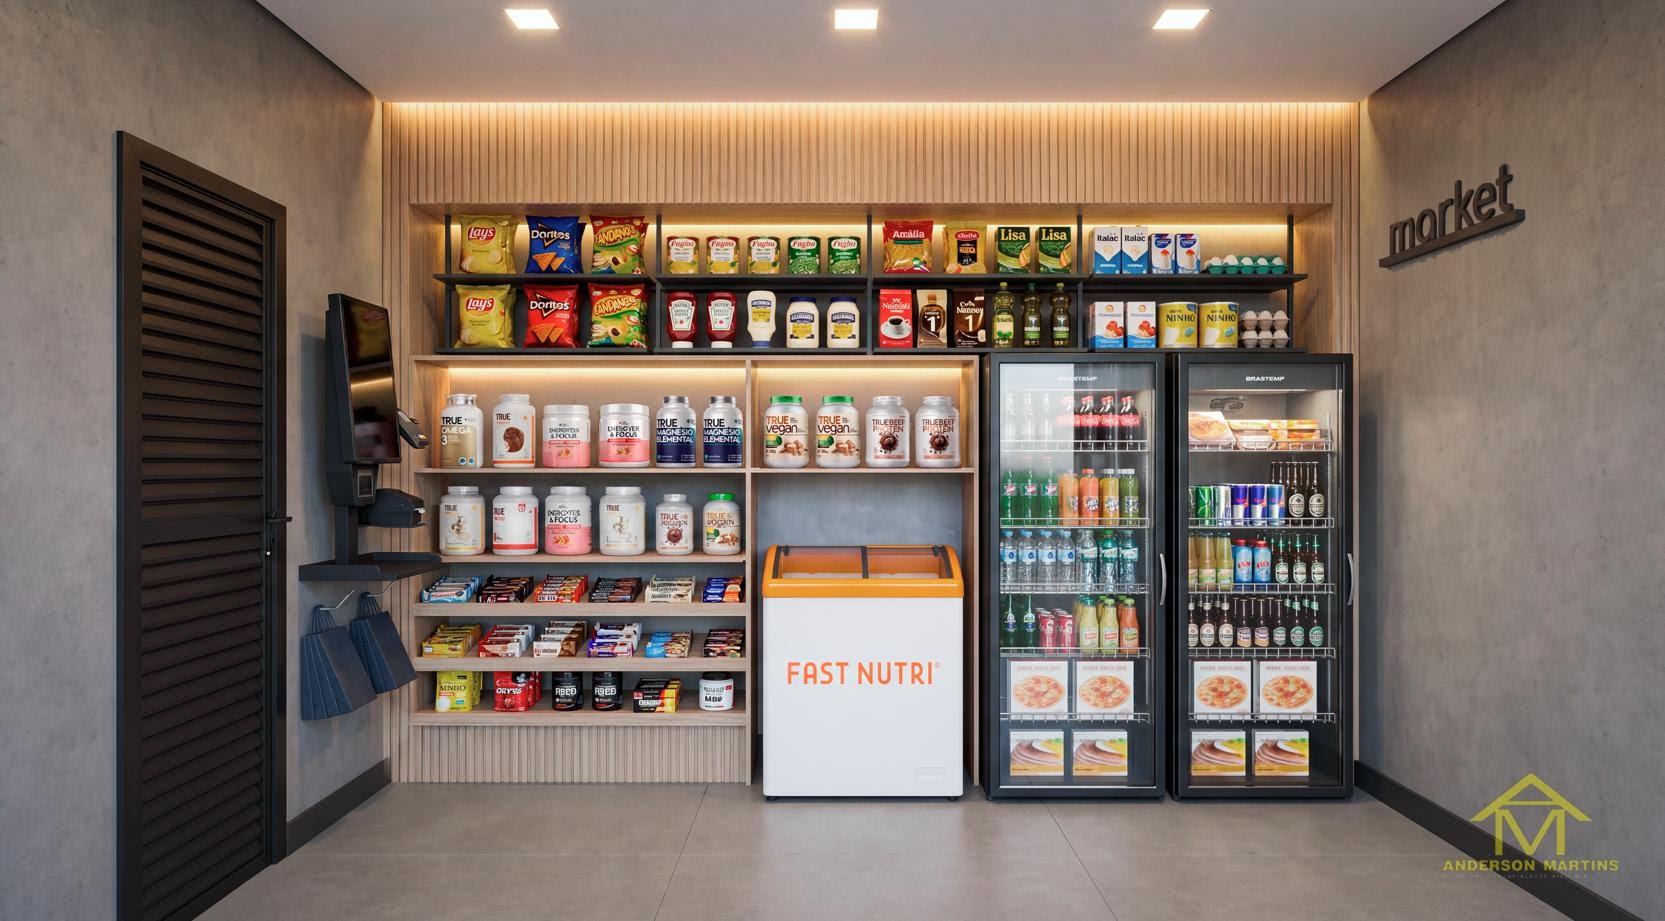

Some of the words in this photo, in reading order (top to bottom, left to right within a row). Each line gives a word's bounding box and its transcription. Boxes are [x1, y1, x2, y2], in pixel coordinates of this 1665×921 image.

[1389, 163, 1513, 256] market
[531, 230, 570, 240] Doritos
[1000, 228, 1026, 240] Lisa
[1041, 228, 1067, 240] Lisa
[529, 300, 570, 310] Doritos
[965, 315, 973, 332] 1
[1166, 314, 1195, 323] NINHO
[1206, 314, 1236, 323] NINHO
[927, 316, 936, 332] 1
[441, 416, 463, 425] TRUE
[496, 413, 511, 421] TRUE
[766, 415, 789, 424] TRUE
[818, 415, 841, 424] TRUE
[657, 418, 678, 427] TRUE
[704, 418, 725, 427] TRUE
[766, 425, 797, 435] vegan
[817, 425, 850, 435] vegan
[441, 435, 448, 446] 3
[787, 661, 849, 685] FAST
